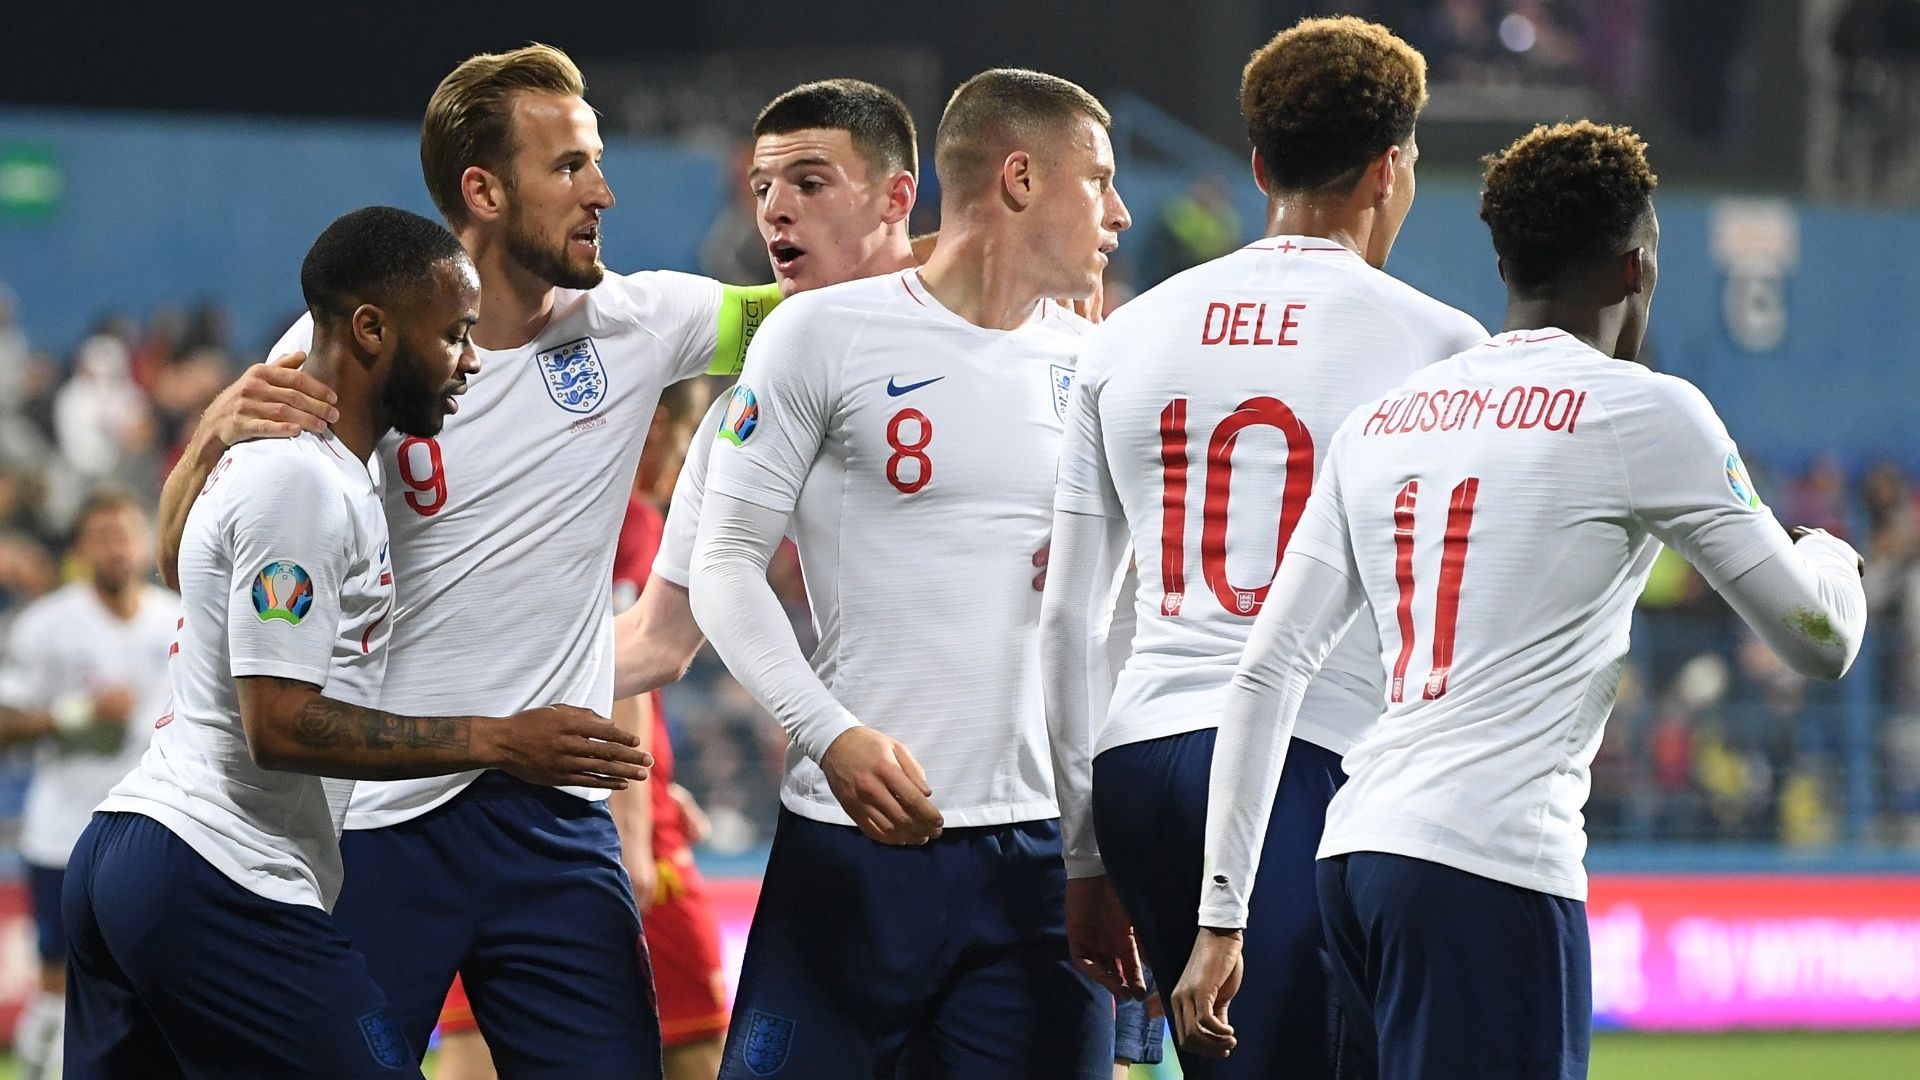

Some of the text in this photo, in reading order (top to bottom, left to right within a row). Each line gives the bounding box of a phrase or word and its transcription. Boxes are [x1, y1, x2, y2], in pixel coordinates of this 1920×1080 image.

[1201, 302, 1306, 346] DELE
[886, 408, 933, 493] 8
[1363, 385, 1587, 436] HUDSON-ODOI
[397, 434, 448, 517] 9
[1159, 396, 1315, 617] 10
[1391, 476, 1479, 702] 11
